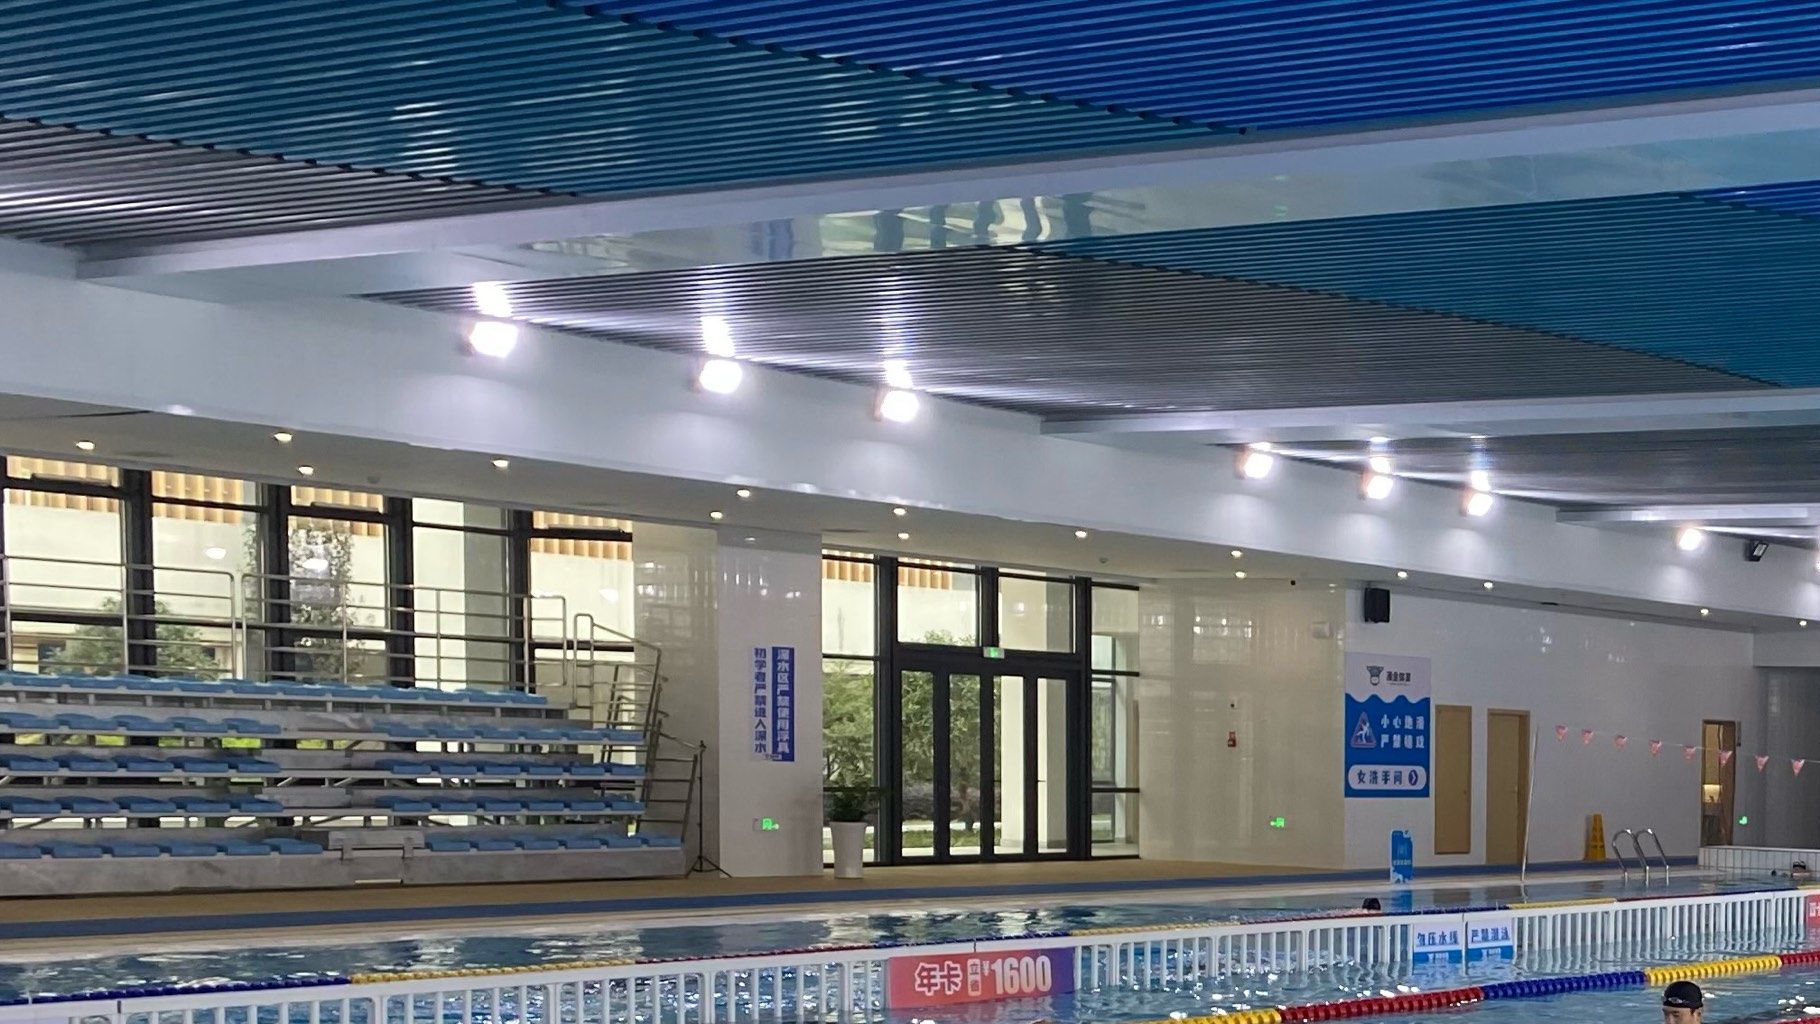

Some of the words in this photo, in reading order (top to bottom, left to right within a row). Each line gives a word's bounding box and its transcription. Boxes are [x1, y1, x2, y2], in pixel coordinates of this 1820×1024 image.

[1380, 714, 1425, 731] 小心地滑
[1357, 769, 1403, 786] 女洗手间
[1417, 930, 1459, 946] 勿压水线
[914, 960, 963, 997] 年卡
